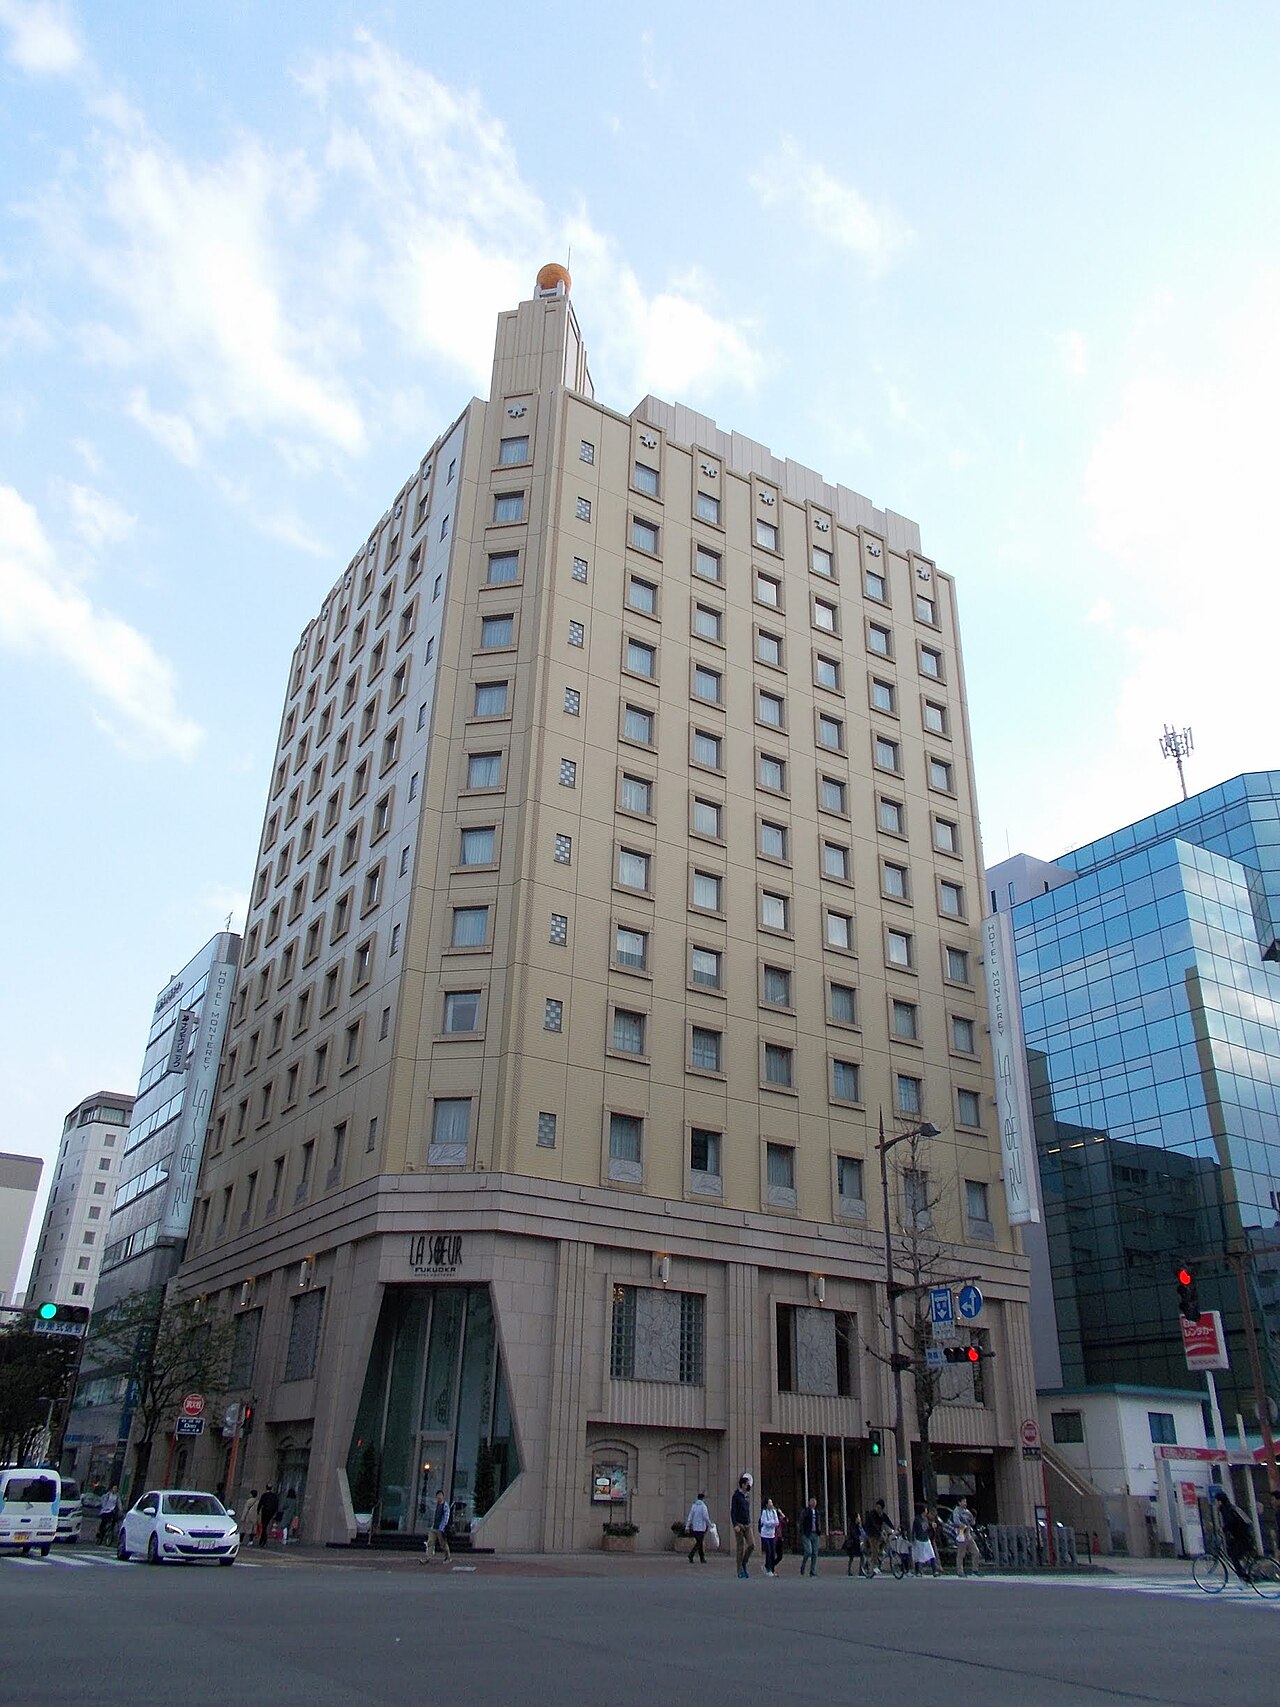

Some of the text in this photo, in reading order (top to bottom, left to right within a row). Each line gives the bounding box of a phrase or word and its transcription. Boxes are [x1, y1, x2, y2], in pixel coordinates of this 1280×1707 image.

[988, 925, 1005, 1036] HOTEL MONTEREY
[204, 970, 226, 1070] HOTEL MONTEREY
[410, 1236, 425, 1265] LA
[1184, 1327, 1214, 1337] レンタカー
